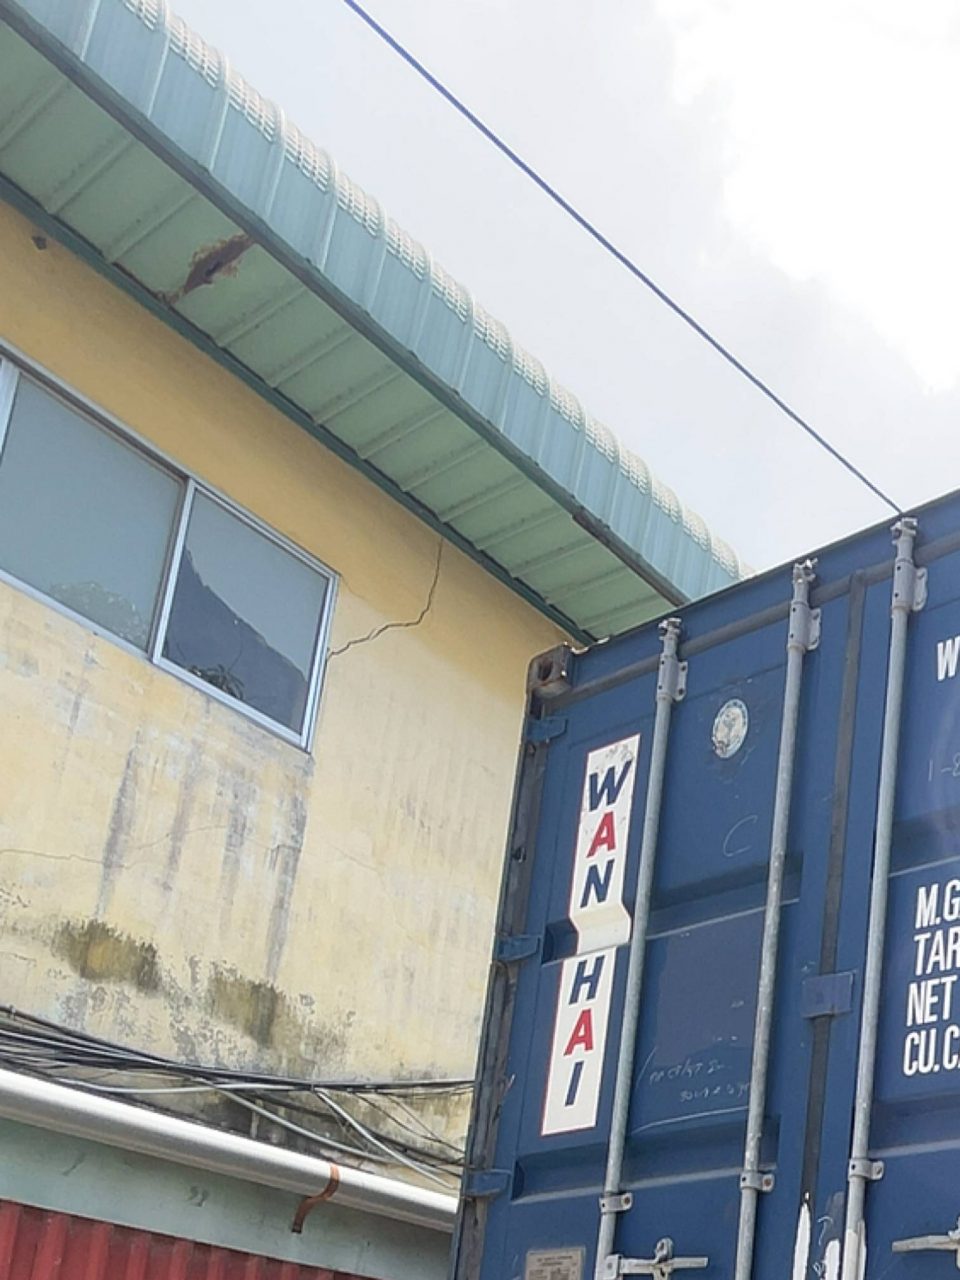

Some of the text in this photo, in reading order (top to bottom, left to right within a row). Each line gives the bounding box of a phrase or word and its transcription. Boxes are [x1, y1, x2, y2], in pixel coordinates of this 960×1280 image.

[582, 760, 632, 908] WAN
[565, 955, 606, 1106] HAI
[906, 974, 958, 1027] NET
